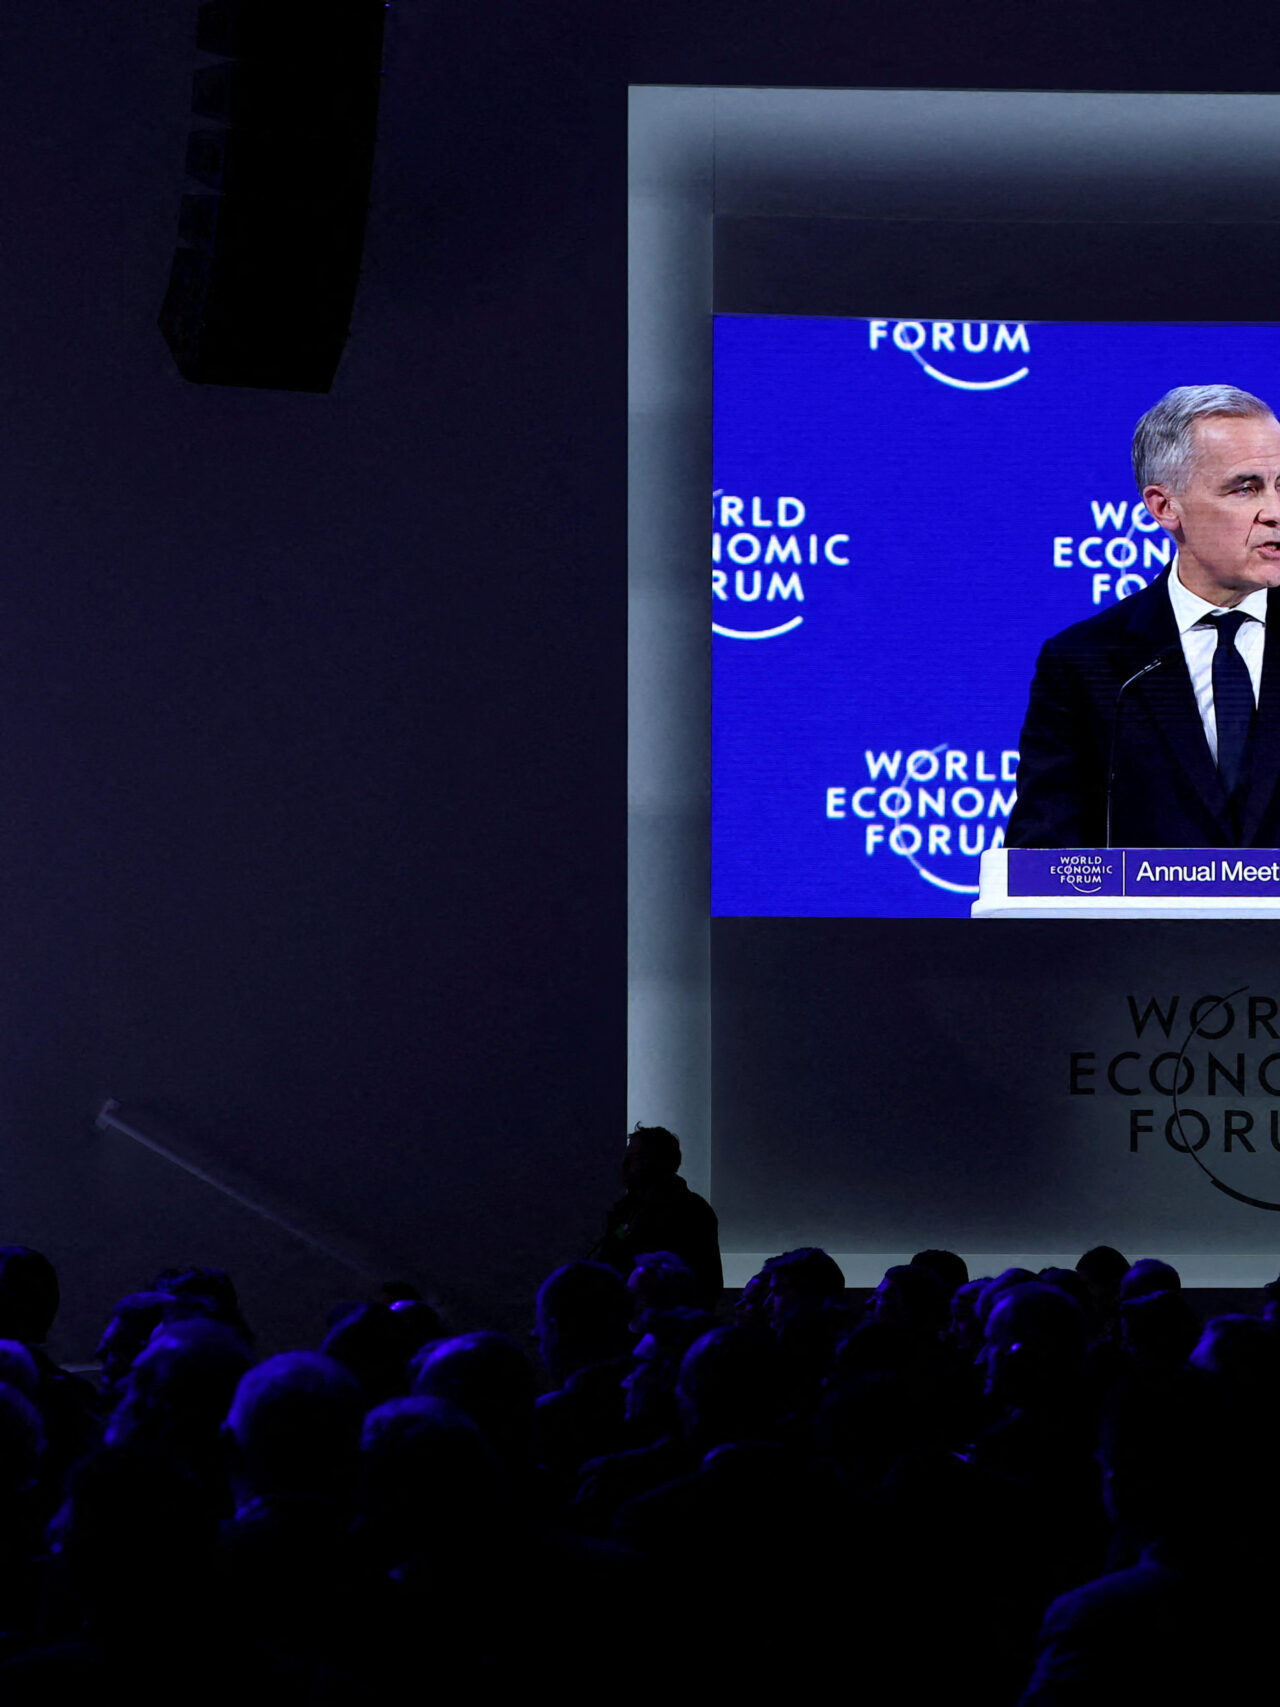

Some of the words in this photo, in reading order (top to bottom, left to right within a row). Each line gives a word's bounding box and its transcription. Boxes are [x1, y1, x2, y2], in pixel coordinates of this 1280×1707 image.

[869, 321, 1030, 352] FORUM
[712, 493, 806, 527] RLD
[711, 532, 850, 565] OMIC
[1050, 865, 1113, 875] ECONOMIC
[1060, 856, 1102, 865] WORLD
[1060, 874, 1102, 884] FORUM
[1136, 861, 1216, 882] Annual
